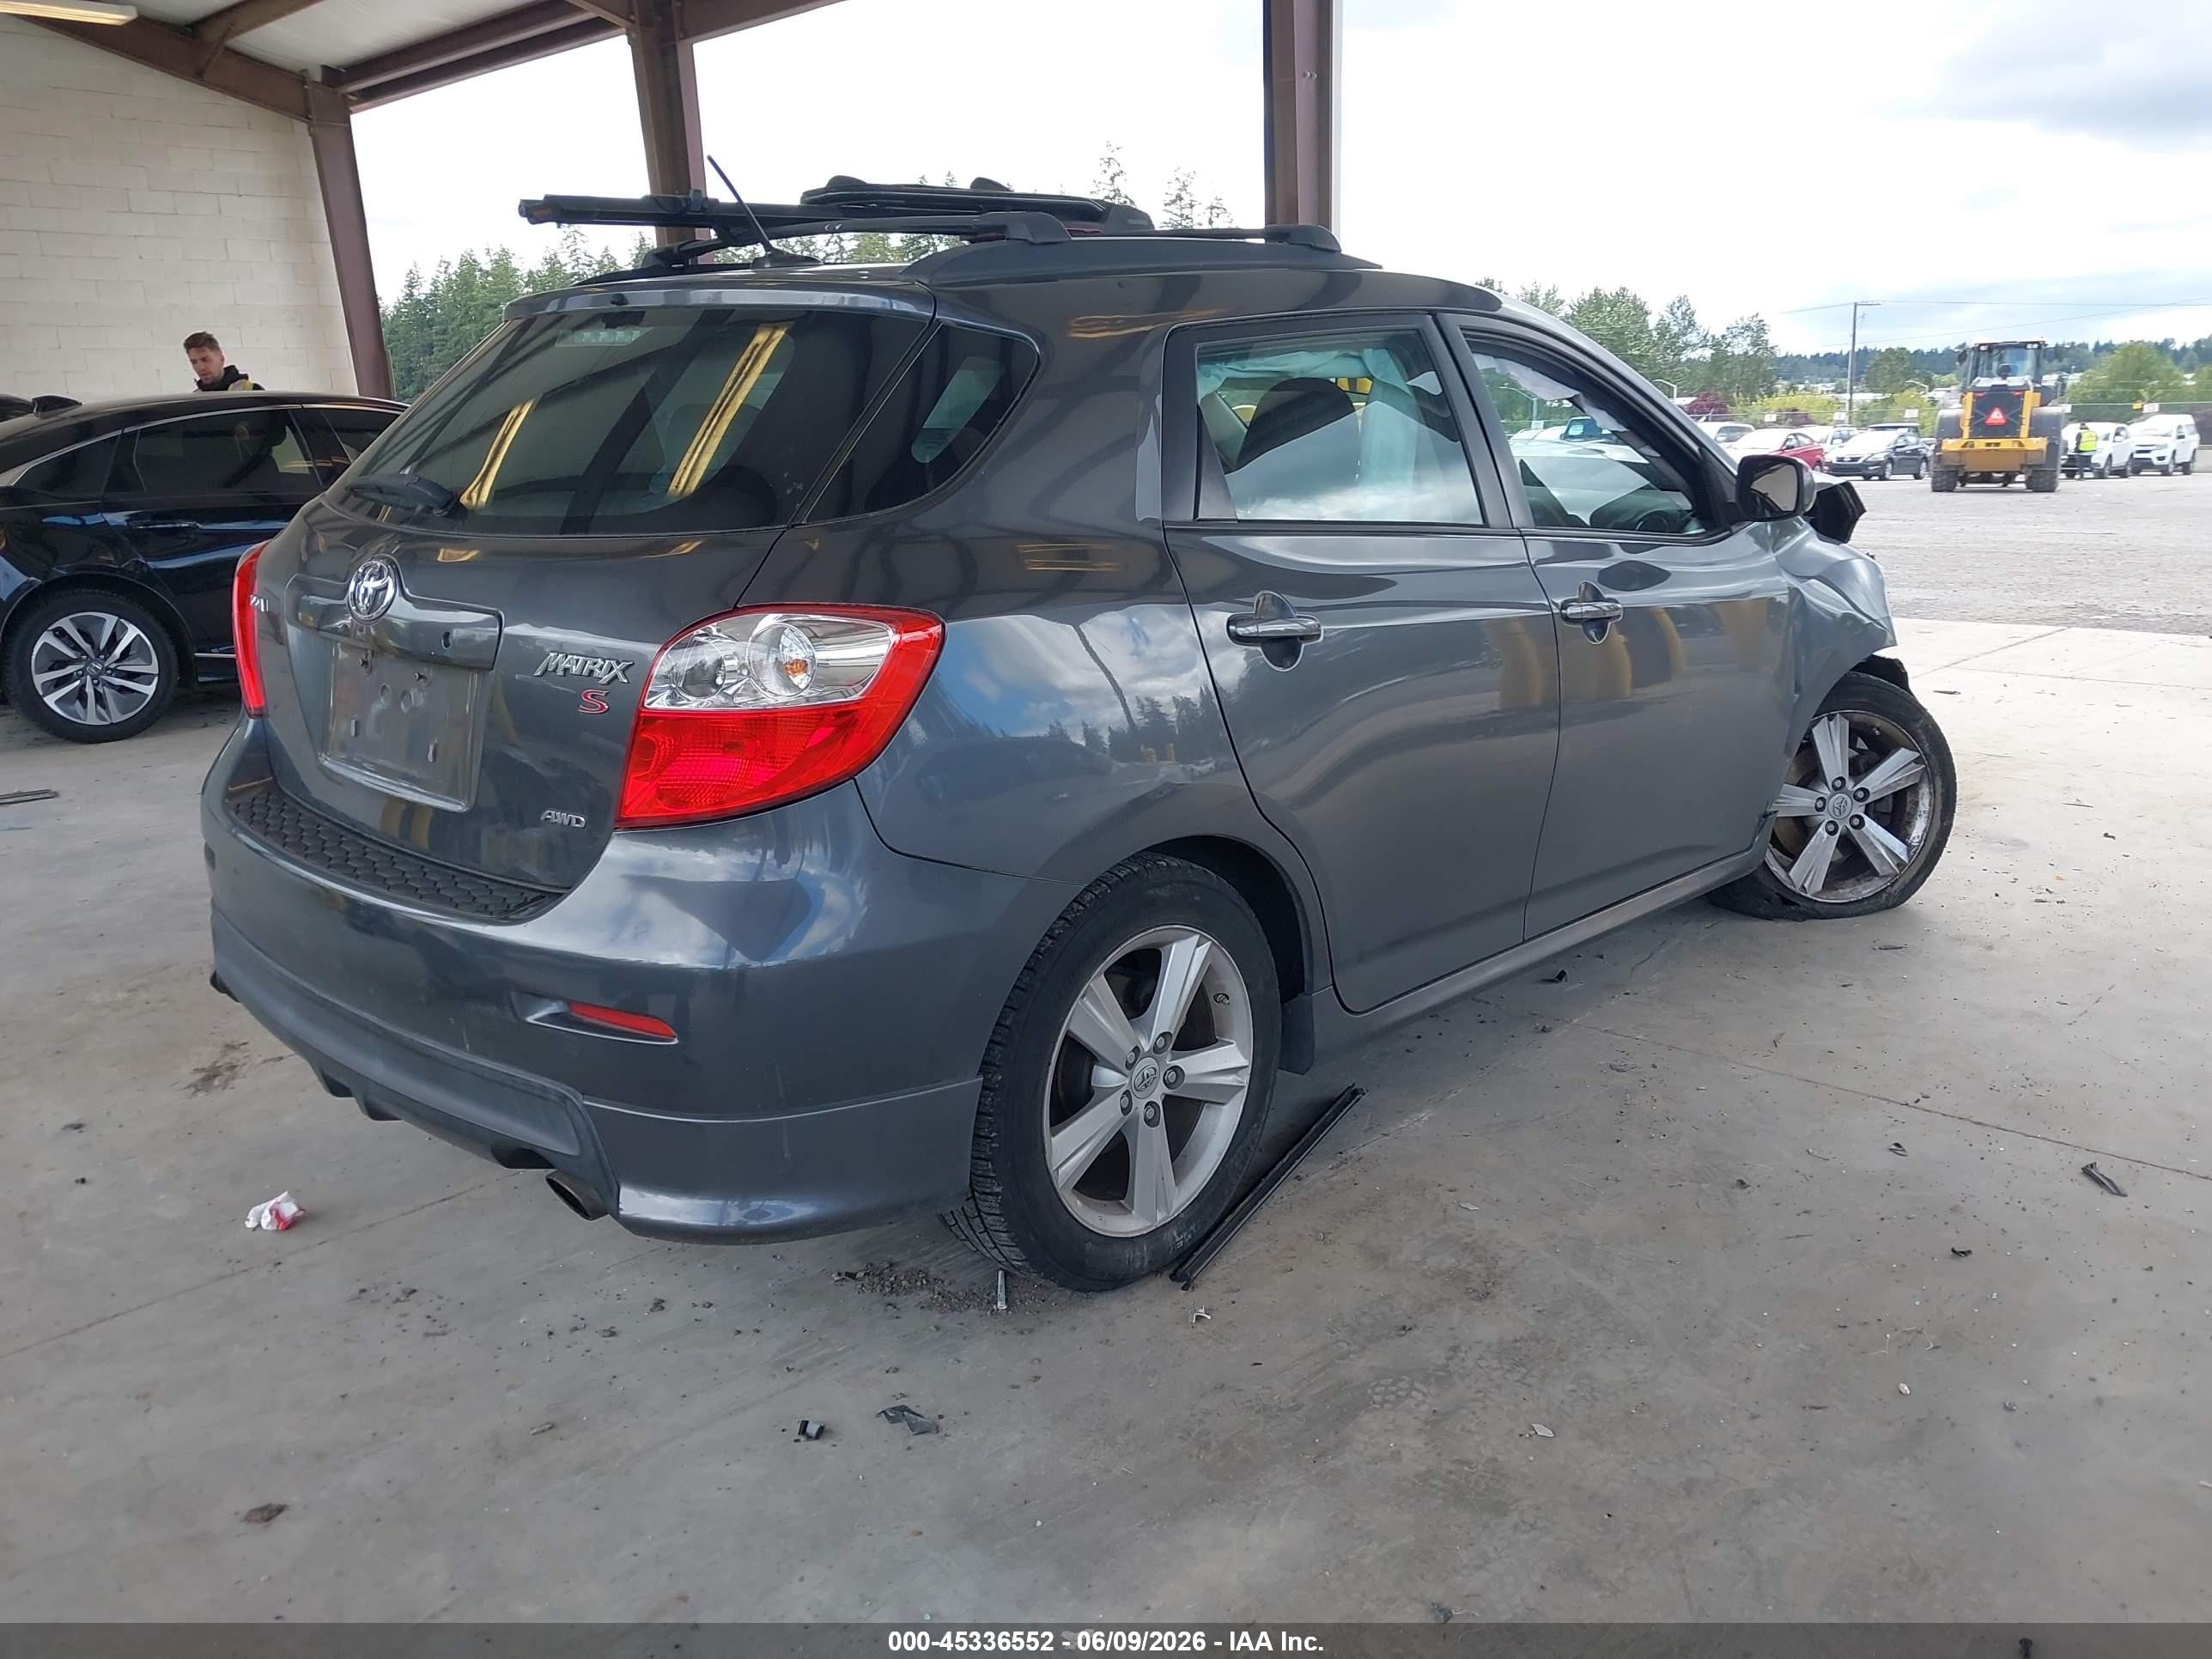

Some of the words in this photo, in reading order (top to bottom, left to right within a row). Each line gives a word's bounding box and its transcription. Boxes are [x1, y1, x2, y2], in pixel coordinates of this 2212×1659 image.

[532, 652, 635, 685] MATRIX
[577, 689, 610, 714] S
[539, 810, 586, 829] AWD
